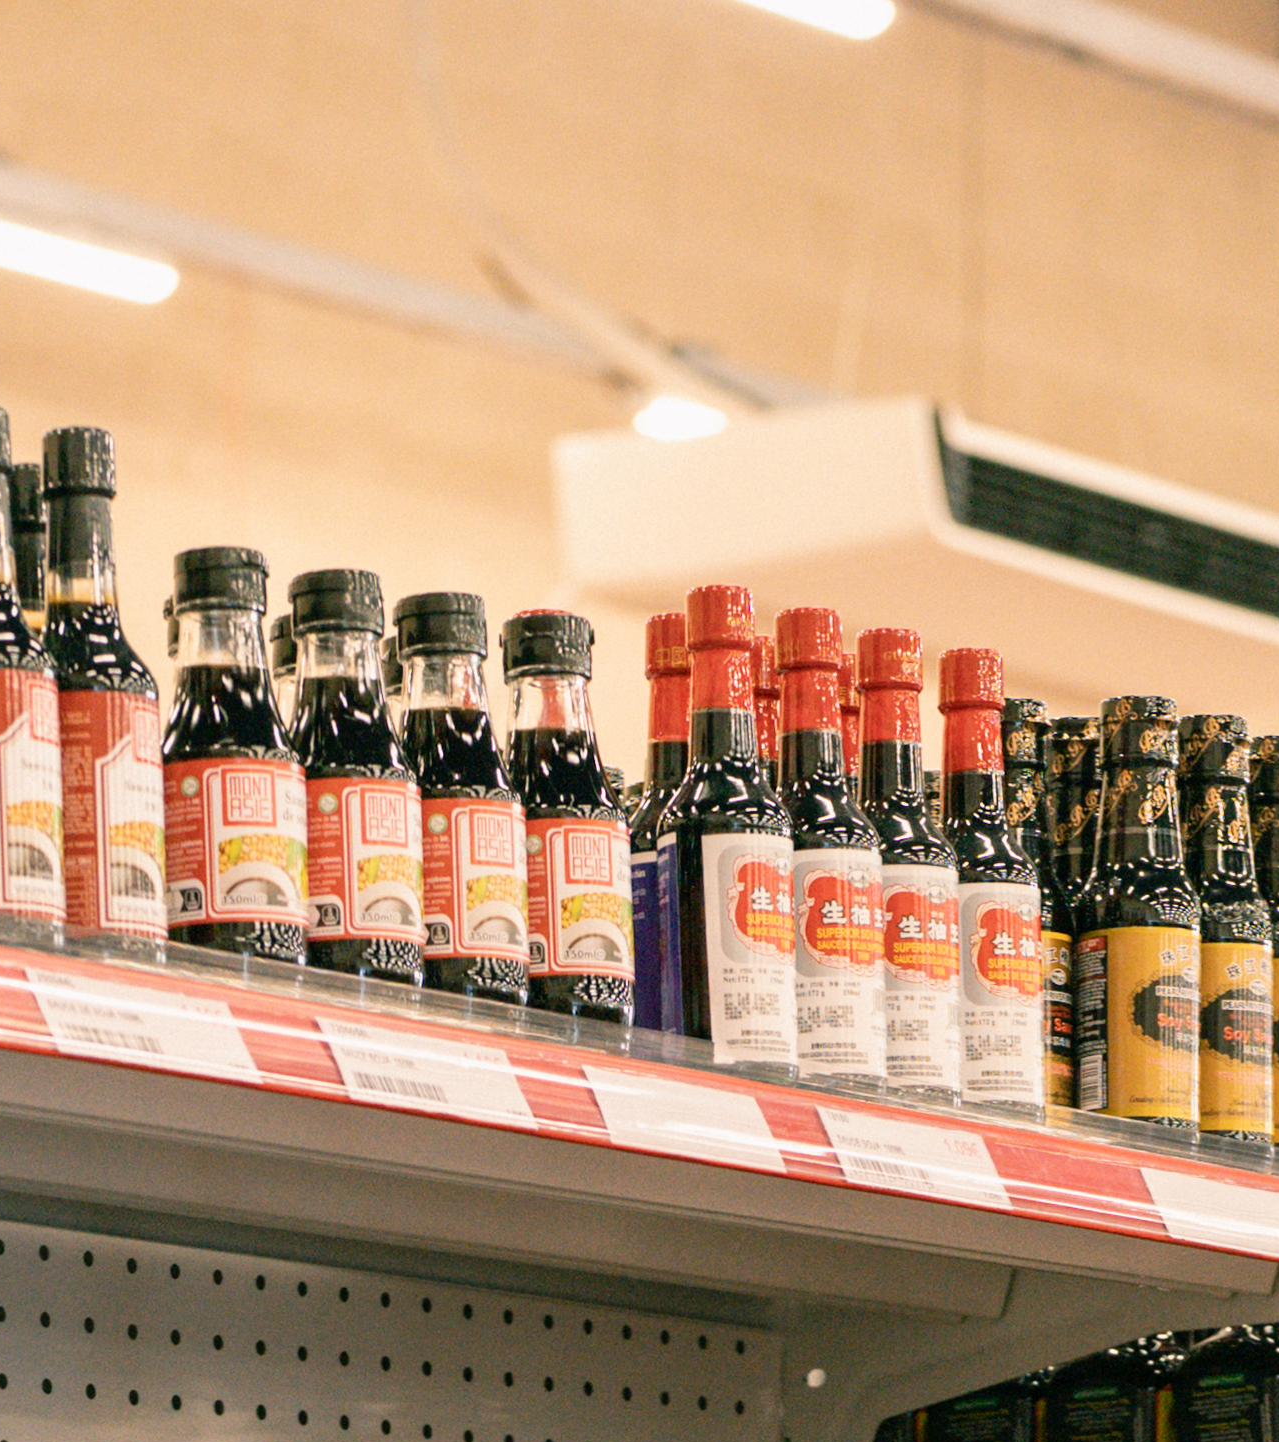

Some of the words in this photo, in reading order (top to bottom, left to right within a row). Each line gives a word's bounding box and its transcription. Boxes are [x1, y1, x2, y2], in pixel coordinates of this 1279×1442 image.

[229, 776, 268, 797] MONT
[230, 801, 270, 821] ASIE
[365, 797, 401, 818] MONT
[367, 819, 403, 839] ASIE
[477, 815, 509, 838] MONT
[478, 840, 511, 860] ASIE
[572, 834, 605, 856] MONT
[573, 857, 607, 878] ASIE
